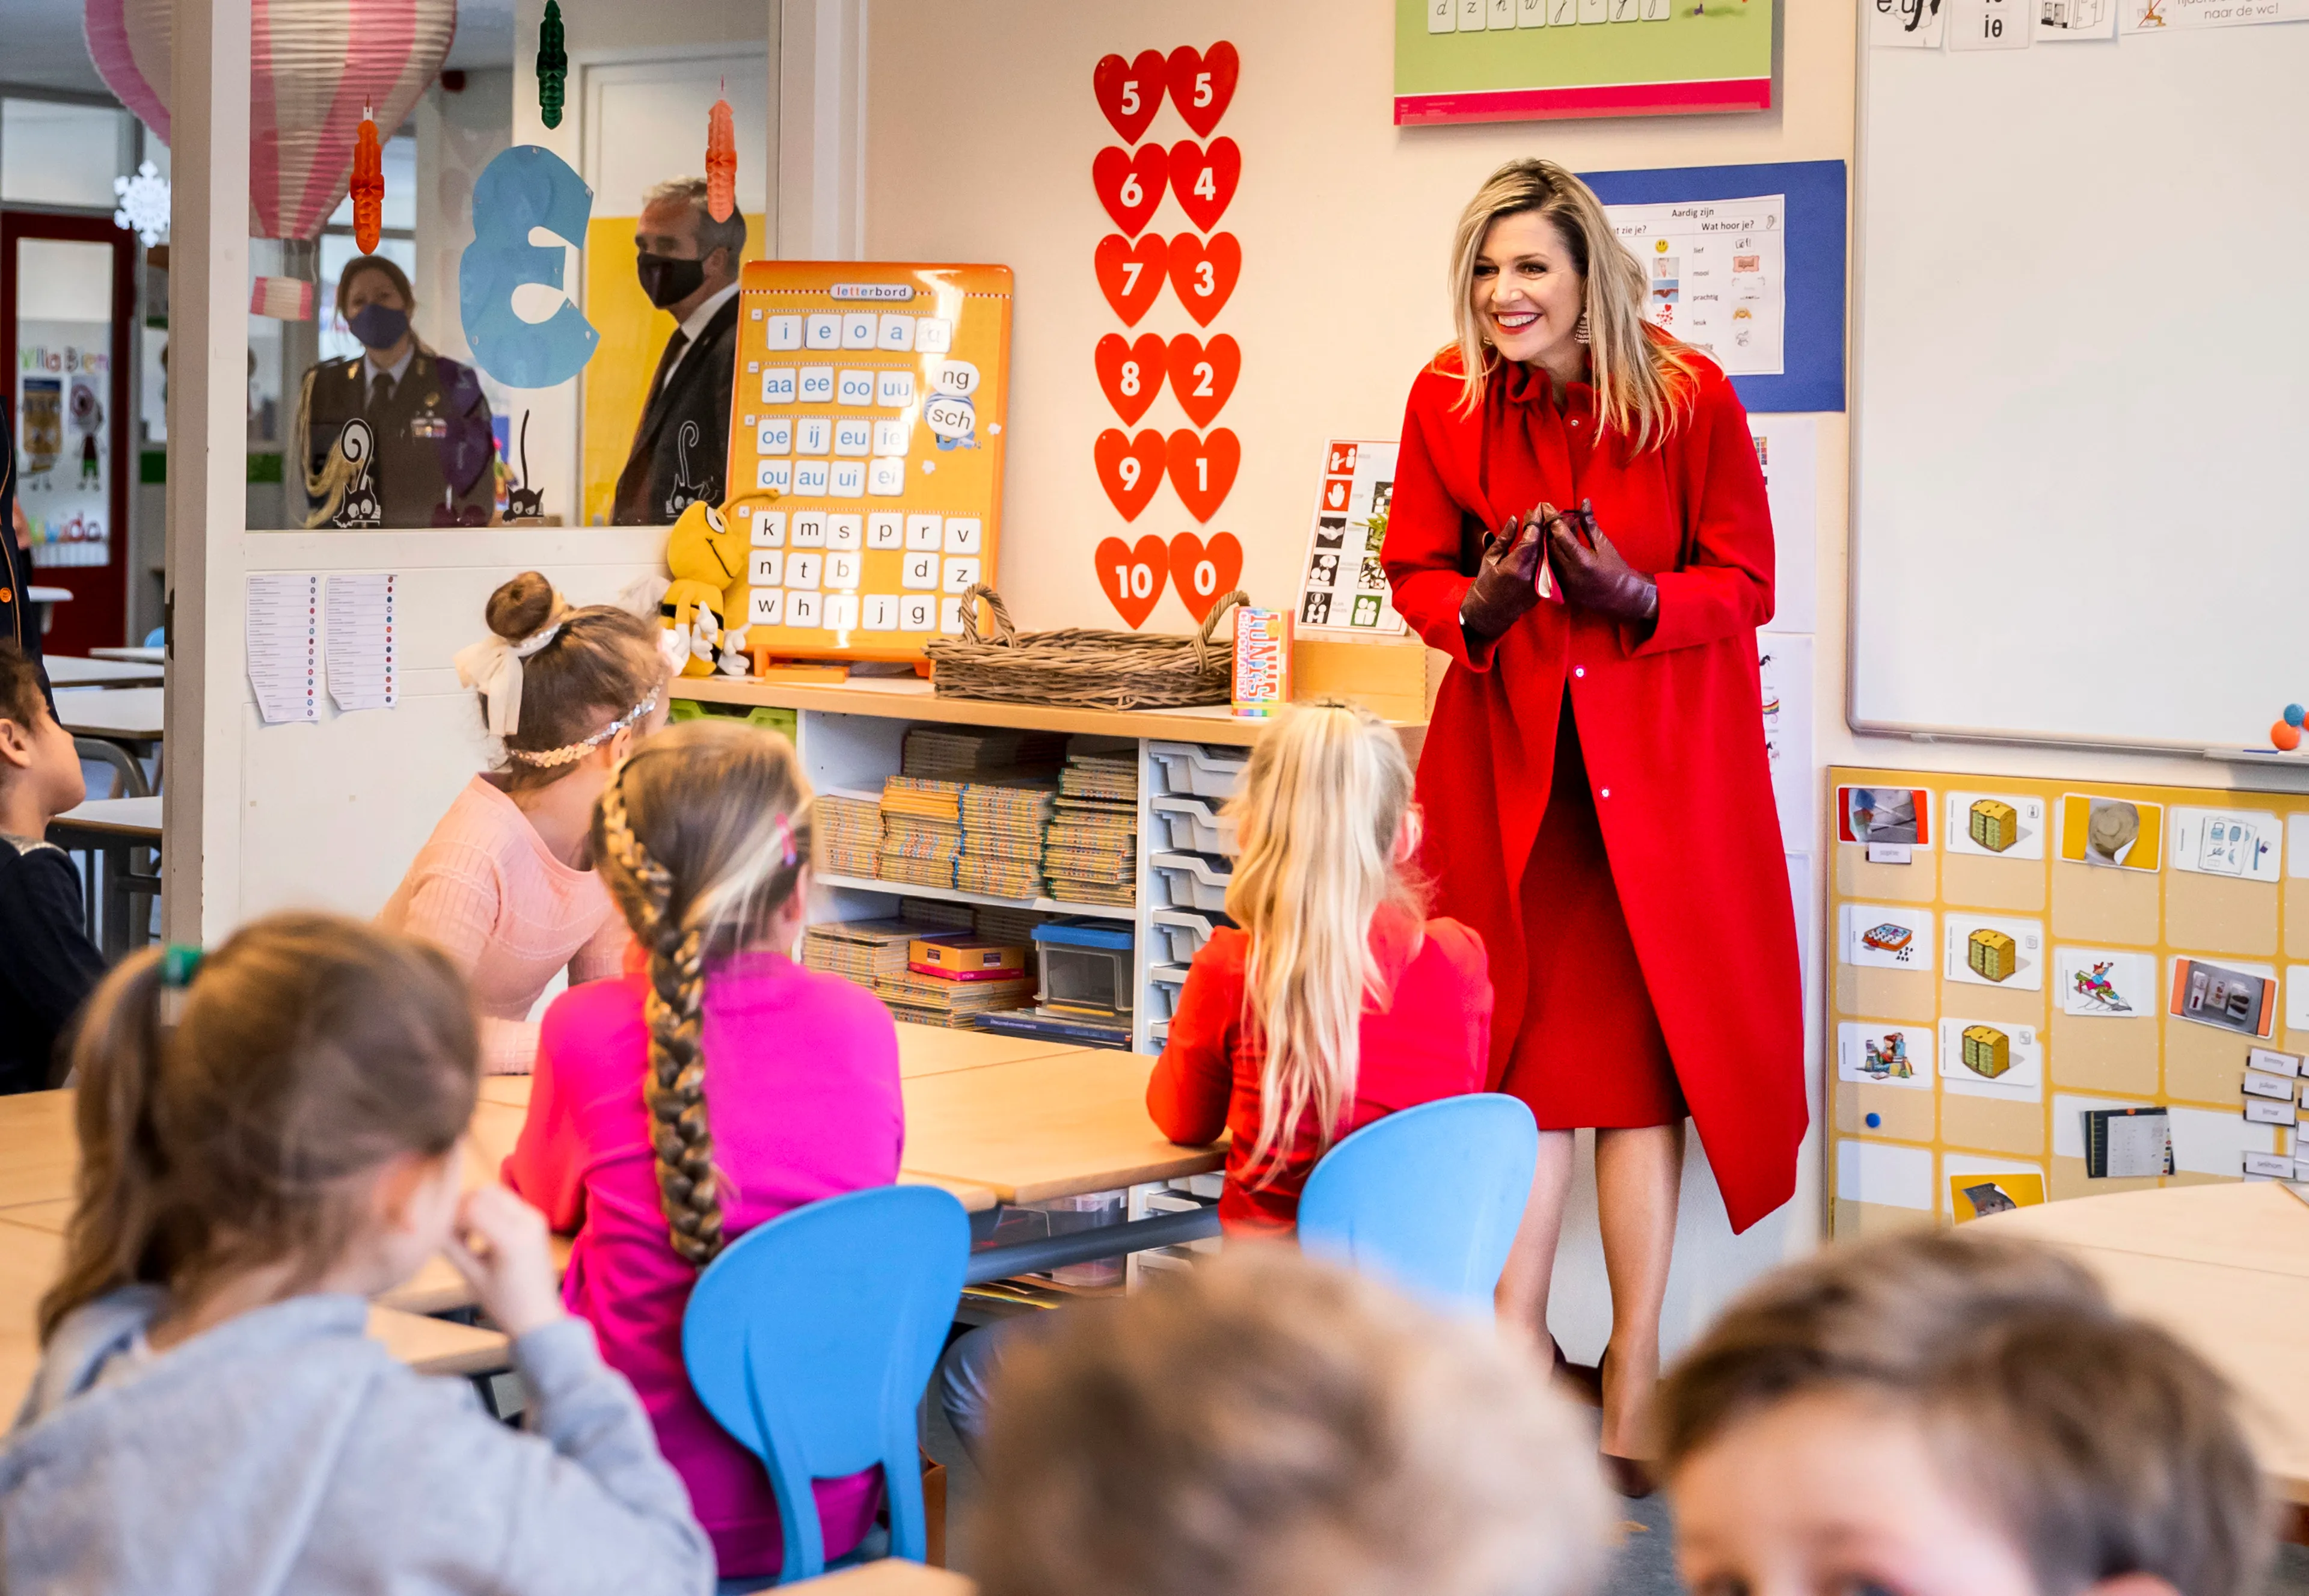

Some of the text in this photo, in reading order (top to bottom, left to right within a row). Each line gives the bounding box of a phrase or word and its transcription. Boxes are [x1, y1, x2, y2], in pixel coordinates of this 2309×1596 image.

[2204, 8, 2233, 19] naar
[2236, 6, 2252, 17] de
[2256, 2, 2279, 14] wc!
[1121, 72, 1213, 115] 5 5
[1120, 167, 1216, 207] 6 4
[1672, 207, 1714, 219] Aardig zijn
[1634, 225, 1647, 236] je?
[1701, 219, 1755, 232] Wat hoor je?
[1121, 260, 1215, 296] 7 3
[837, 285, 907, 296] letterbord
[783, 323, 788, 340] i
[819, 325, 831, 339] e
[854, 325, 867, 339] o
[891, 327, 903, 340] a
[767, 378, 909, 396] aa ee oo uu
[942, 370, 969, 390] ng
[1120, 361, 1213, 396] 8 2
[932, 408, 971, 430] sch
[762, 426, 900, 448] oe ij eu ie
[762, 467, 896, 486] ou au ui ei
[1119, 456, 1207, 491] 9 1
[764, 518, 969, 542] k m s p r v
[760, 560, 967, 583] n t b d z
[1115, 560, 1216, 600] 10 0
[759, 600, 775, 613] w
[798, 599, 809, 616] h
[878, 602, 884, 624] j
[912, 606, 924, 624] g
